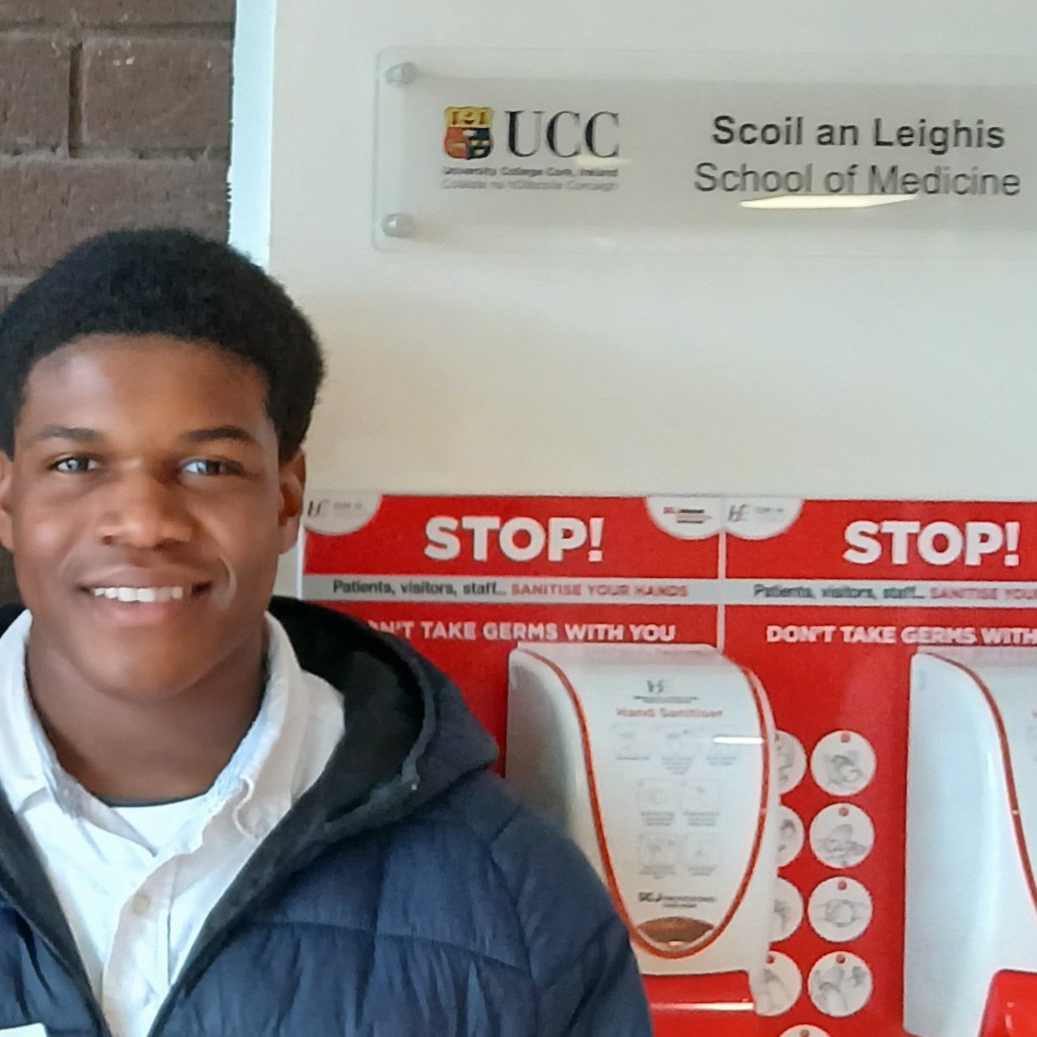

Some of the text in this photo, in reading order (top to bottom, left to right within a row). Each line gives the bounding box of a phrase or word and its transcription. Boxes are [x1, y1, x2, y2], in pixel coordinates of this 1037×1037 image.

[505, 110, 619, 158] UCC
[712, 114, 1006, 156] Scoil an Leighis
[694, 161, 1021, 196] School of Medicine
[423, 515, 605, 563] STOP!
[842, 520, 1021, 567] STOP!
[333, 579, 396, 596] Patients,
[400, 581, 457, 596] visitors,
[511, 583, 582, 597] SANITISE
[587, 584, 630, 597] YOUR
[420, 621, 476, 641] TAKE
[482, 622, 558, 642] GERMS
[565, 623, 624, 642] WITH
[629, 624, 676, 642] YOU
[766, 624, 1037, 646] DON'T TAKE GERMS WITH
